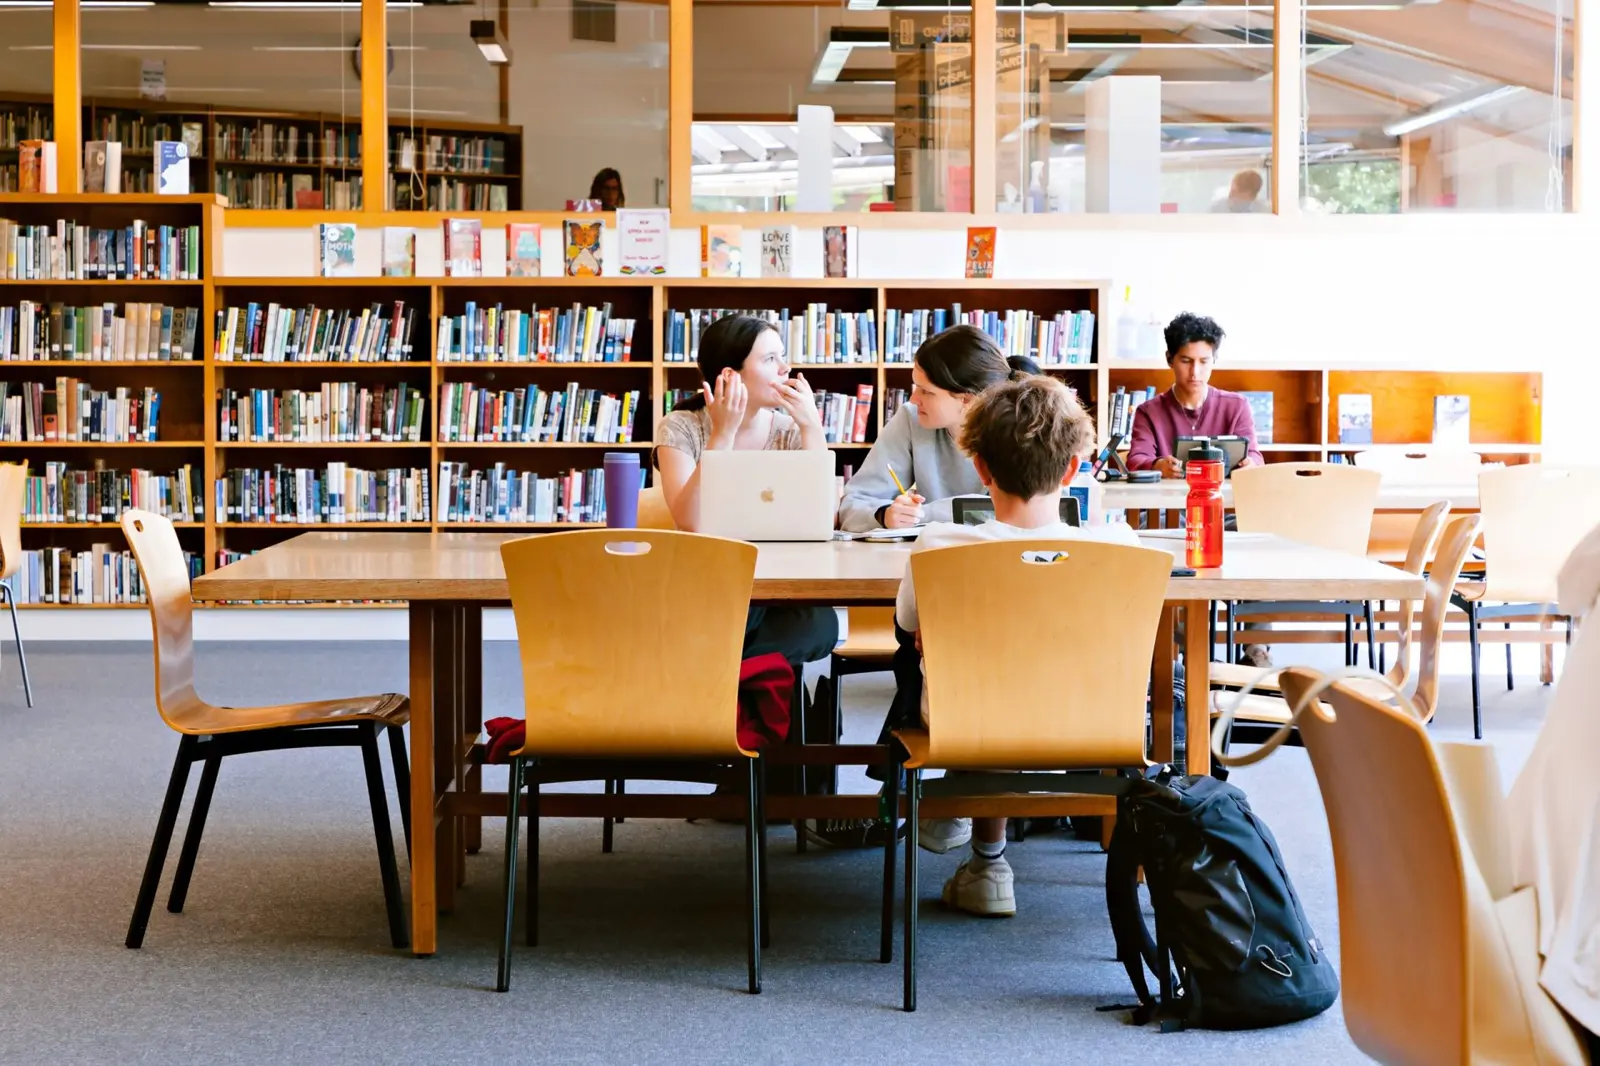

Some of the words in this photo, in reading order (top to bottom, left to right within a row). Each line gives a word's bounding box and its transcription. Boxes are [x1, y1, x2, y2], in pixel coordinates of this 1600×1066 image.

[939, 69, 971, 87] DISPL
[996, 55, 1025, 71] OARD
[763, 245, 790, 255] HATE
